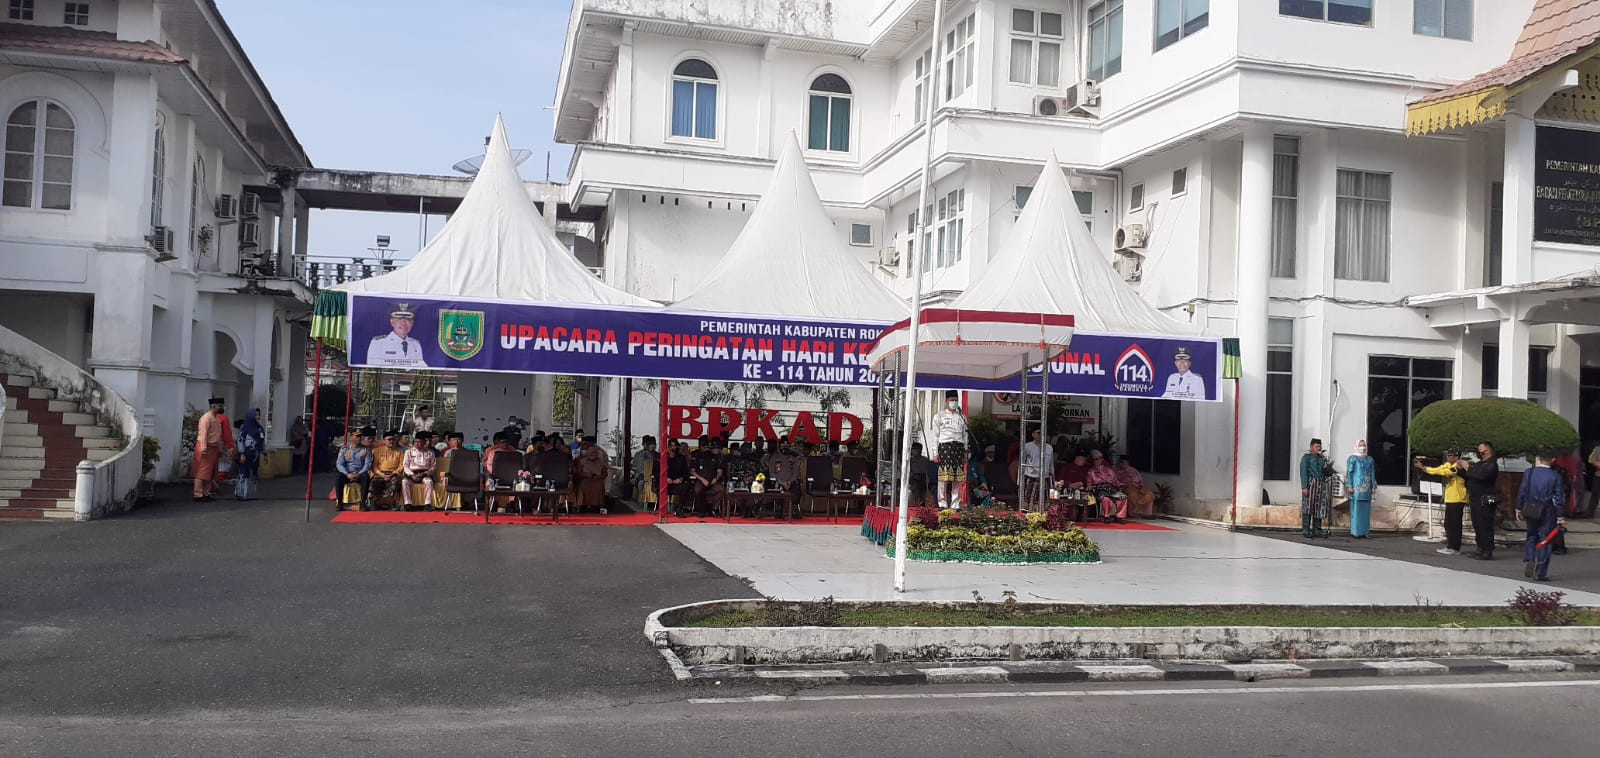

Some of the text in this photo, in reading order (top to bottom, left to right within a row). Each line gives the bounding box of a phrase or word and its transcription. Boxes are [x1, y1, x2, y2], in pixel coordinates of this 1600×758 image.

[700, 320, 883, 340] PEMERINTAH KABUPATEN ROK
[500, 323, 1106, 376] UPACARA PERINGATAN HARI KE ONAL
[743, 363, 761, 379] KE
[778, 365, 804, 380] 114
[809, 366, 854, 382] TAHUN
[859, 368, 893, 384] 202
[1119, 364, 1148, 382] 114
[1064, 408, 1090, 417] ORKAN
[668, 405, 864, 445] BPKAD
